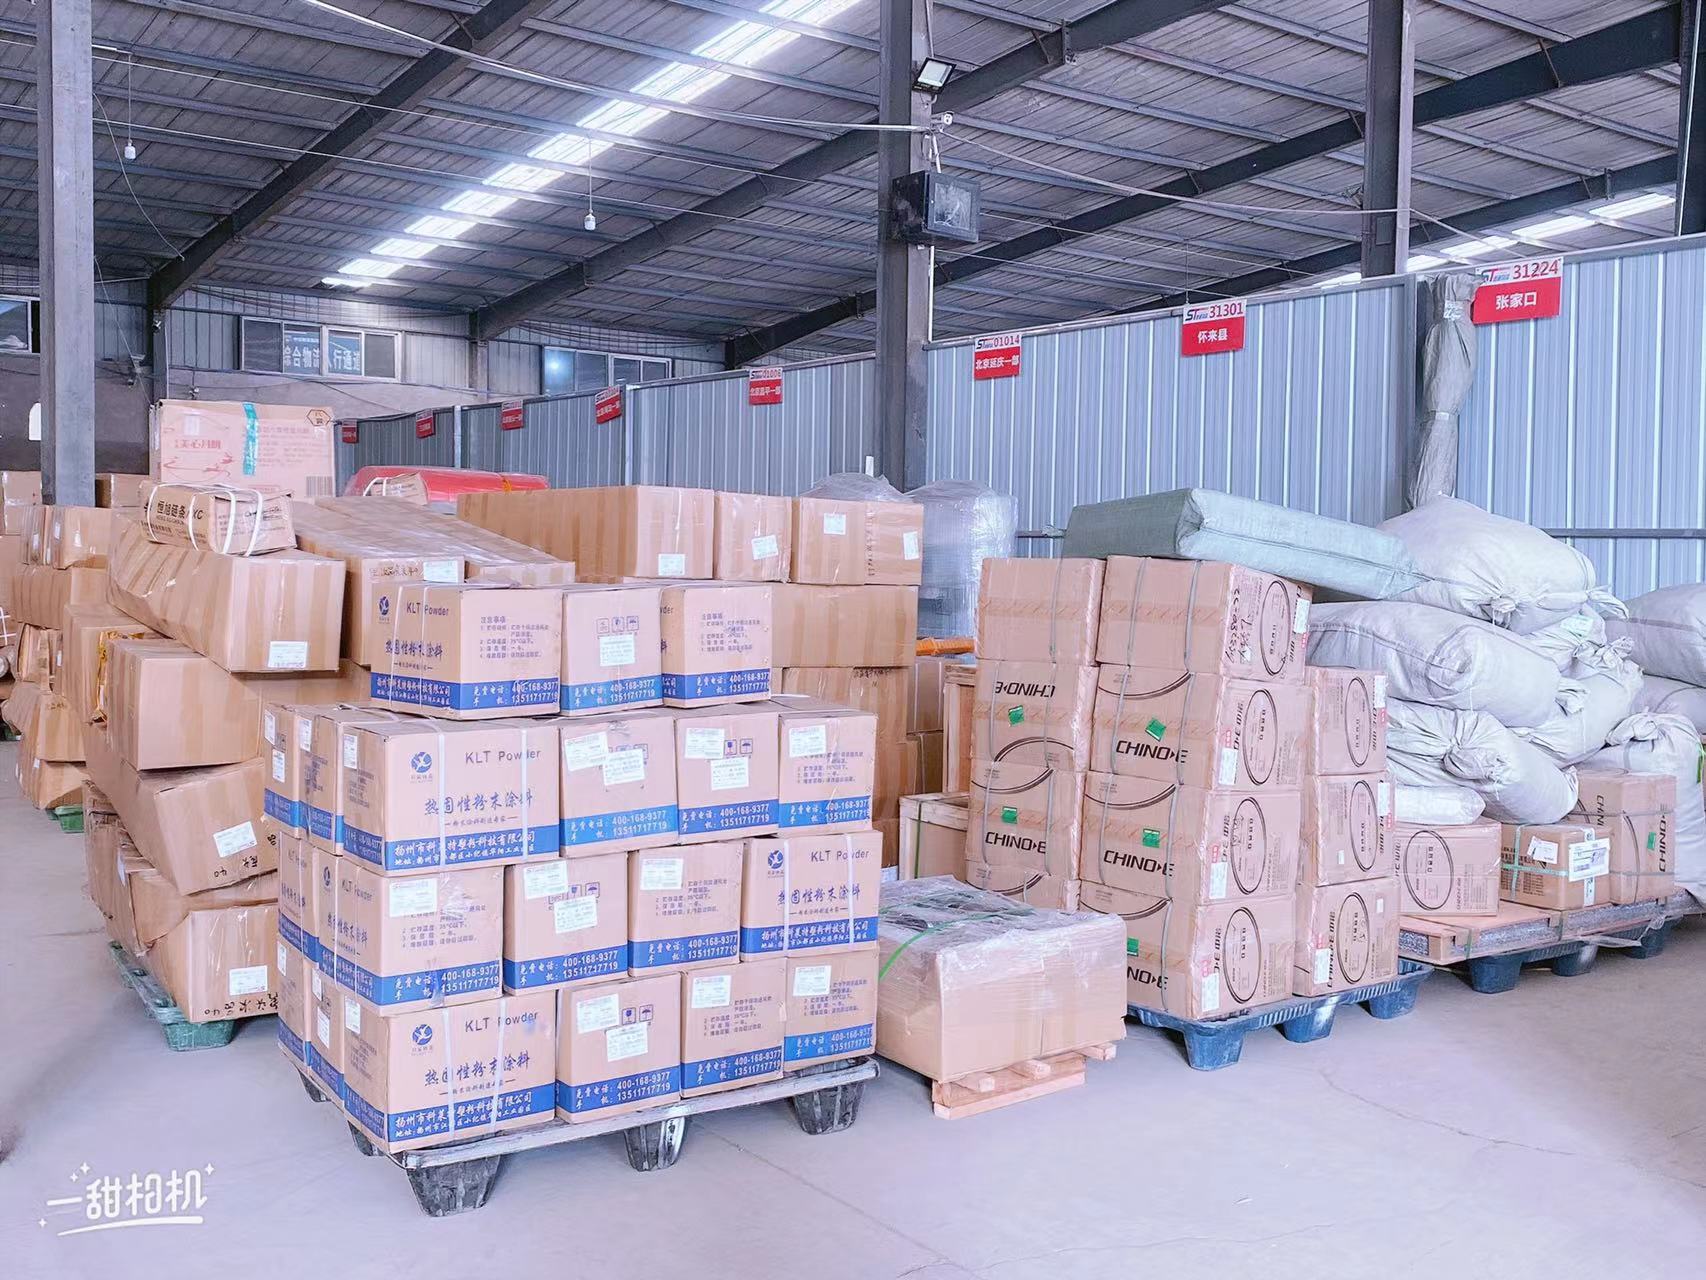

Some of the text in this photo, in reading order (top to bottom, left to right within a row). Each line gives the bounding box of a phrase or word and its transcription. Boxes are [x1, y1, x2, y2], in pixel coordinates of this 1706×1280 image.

[1512, 260, 1558, 280] 31224
[1496, 292, 1537, 310] 张家口
[1209, 302, 1243, 318] 31301
[994, 334, 1020, 348] 01014
[1198, 328, 1228, 344] 怀来县
[406, 602, 448, 616] KLT Powder
[610, 679, 655, 691] 400-168-9377
[610, 689, 655, 702] 13511717719
[465, 750, 490, 764] KLT
[612, 810, 667, 826] 400-168-9377
[720, 804, 770, 817] 400-168-9377
[612, 820, 668, 836] 13511717719
[720, 814, 770, 828] 13511717719
[811, 850, 830, 862] KLT
[688, 934, 737, 948] 400-168-9377
[562, 951, 618, 968] 400-168-9377
[442, 964, 498, 981] 400-168-9377
[562, 962, 618, 978] 13511717719
[441, 976, 499, 994] 13511717719
[465, 1017, 490, 1032] KLT
[734, 1050, 780, 1066] 400-168-9377
[616, 1072, 671, 1091] 400-168-9377
[616, 1083, 672, 1100] 13511717719
